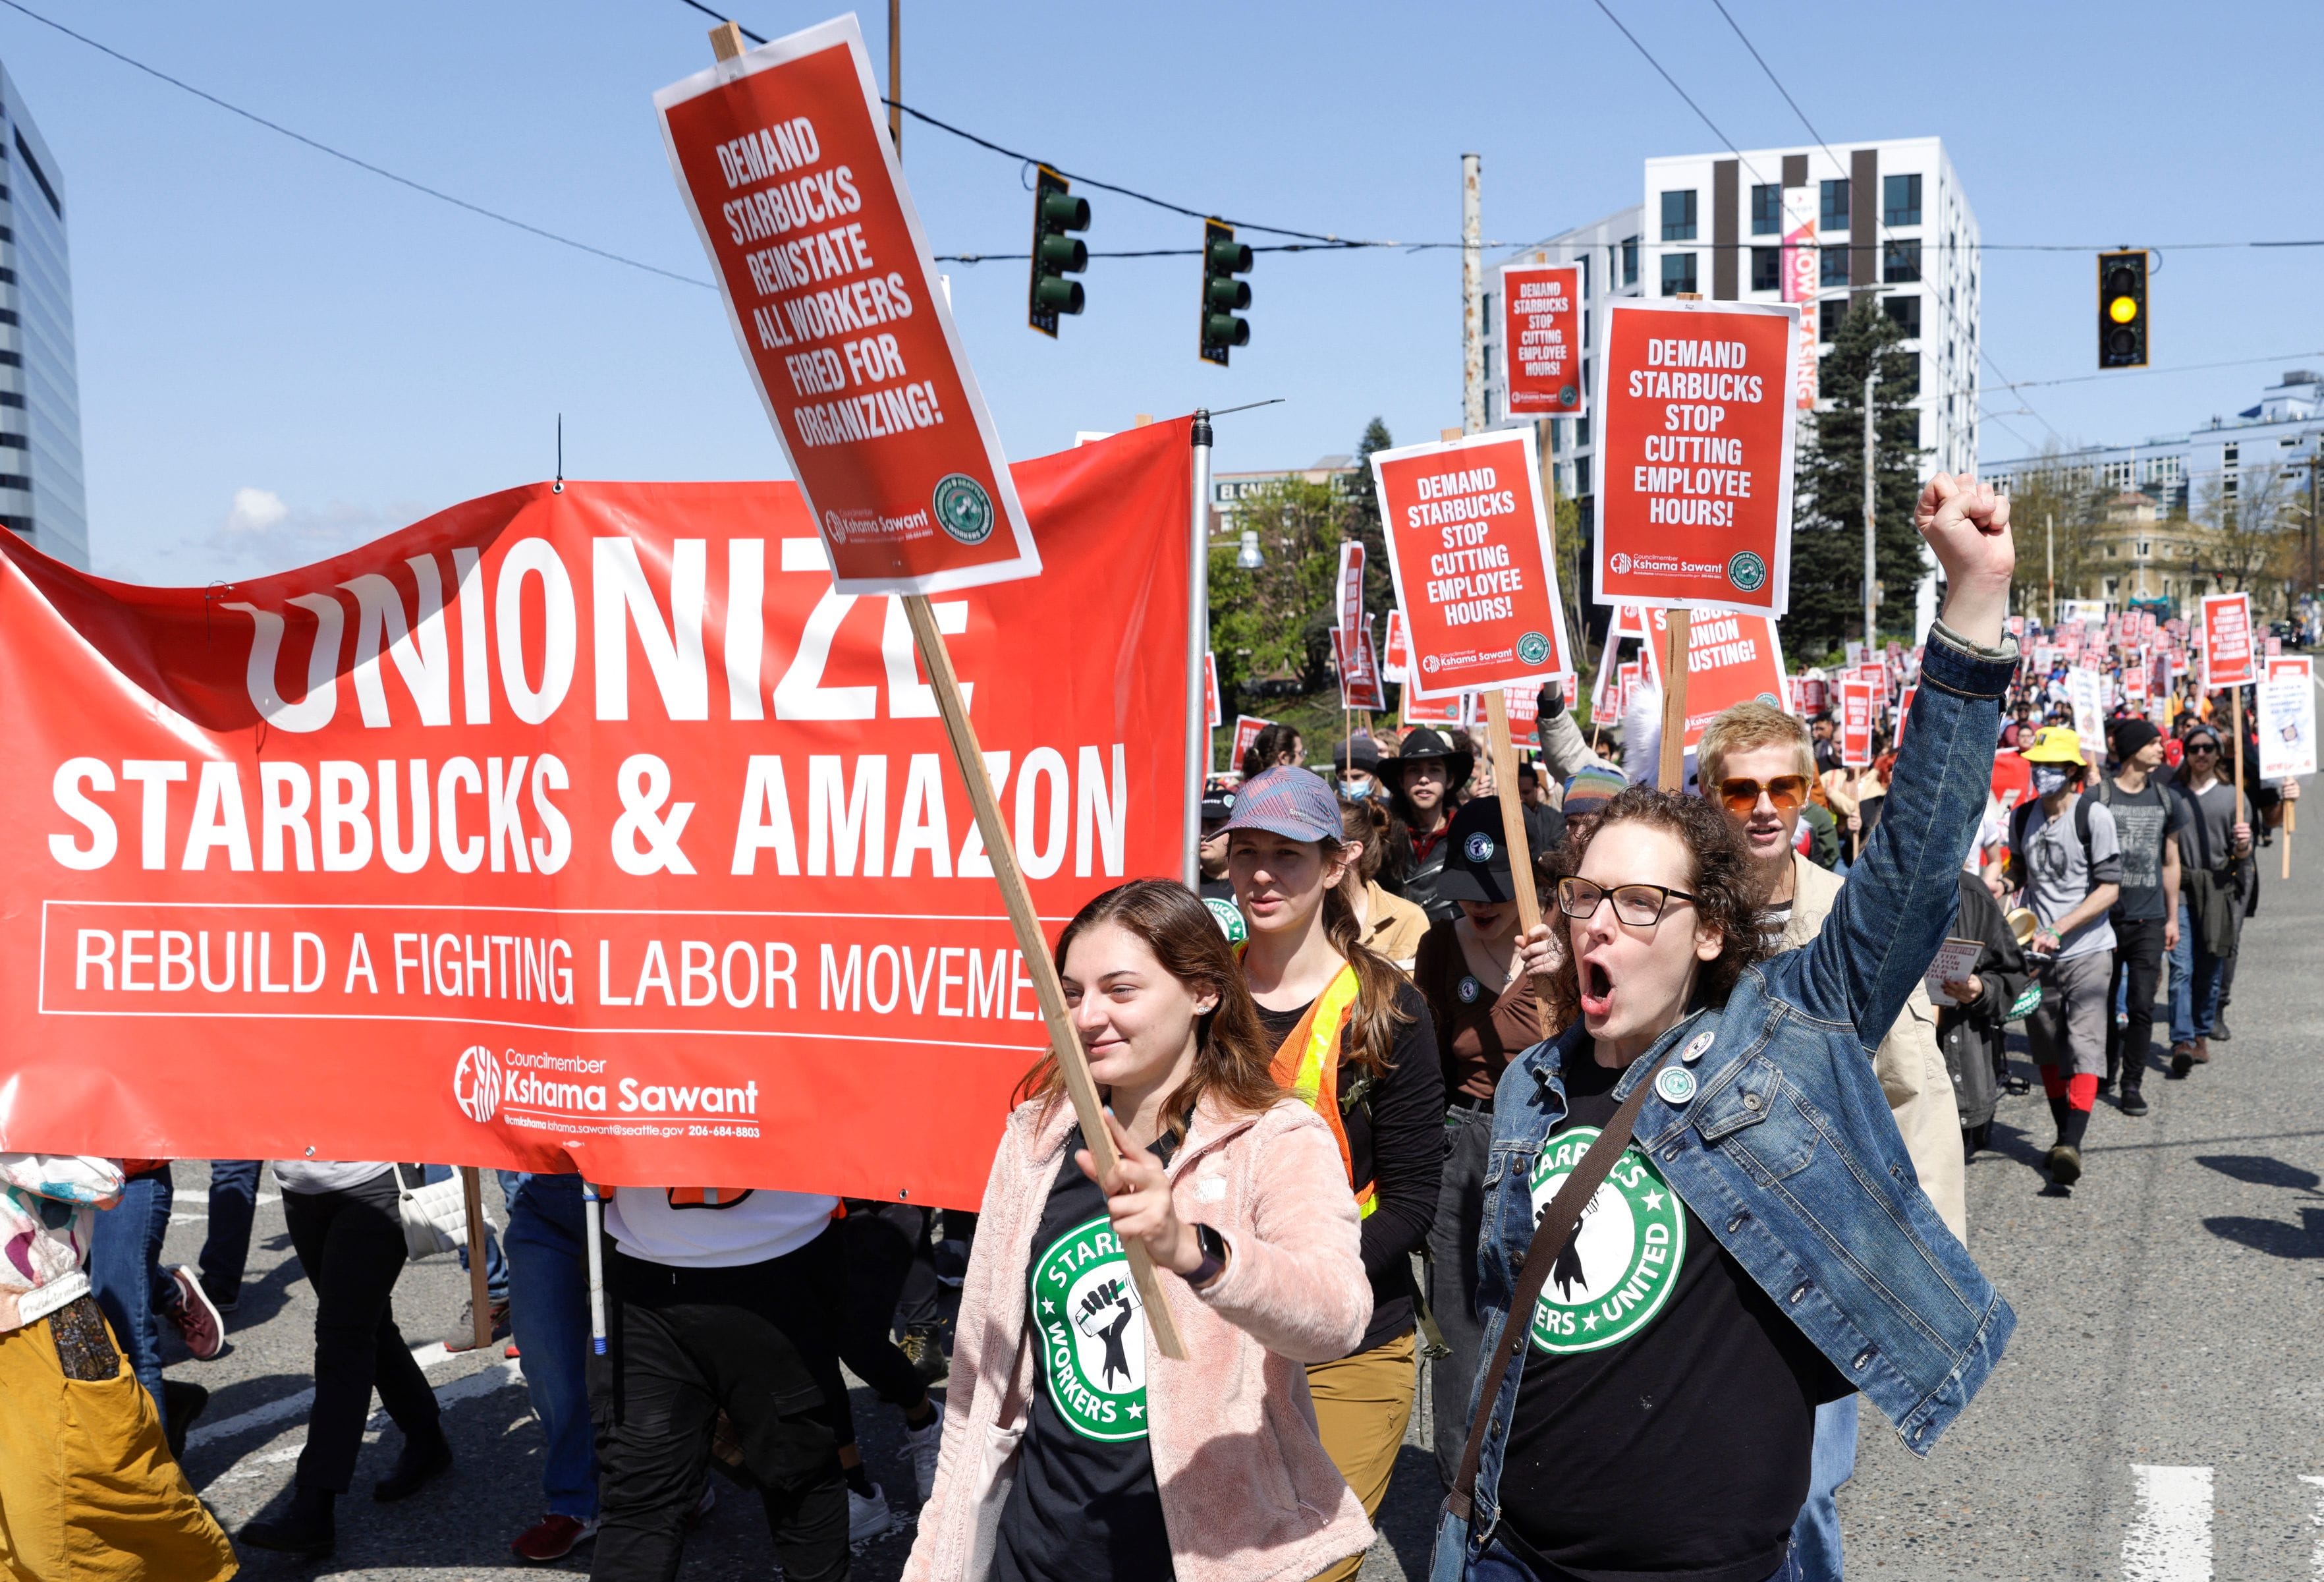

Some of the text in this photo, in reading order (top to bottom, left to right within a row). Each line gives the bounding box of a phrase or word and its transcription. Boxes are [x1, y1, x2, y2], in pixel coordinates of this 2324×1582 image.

[716, 116, 820, 190] DEMAND
[723, 166, 862, 246] STARBUCKS
[746, 222, 873, 297] REINSTATE
[1796, 236, 1815, 295] NOW
[1514, 297, 1568, 314] STARBUCKS
[1520, 282, 1561, 298] DEMAND
[753, 272, 913, 351] ALL WORKERS
[1529, 314, 1553, 329] STOP
[1518, 345, 1566, 360] EMPLOYEE
[1522, 330, 1561, 345] CUTTING
[1647, 337, 1747, 369] DEMAND
[785, 333, 906, 397] FIRED FOR
[1526, 361, 1560, 376] HOURS!
[1628, 370, 1763, 403] STARBUCKS
[794, 381, 945, 448] ORGANIZING!
[1665, 404, 1725, 432] STOP
[1645, 436, 1742, 466] CUTTING
[1417, 467, 1496, 501] DEMAND
[1634, 466, 1751, 498] EMPLOYEE
[843, 509, 929, 534] Kshama Sawant
[1407, 491, 1515, 528] STARBUCKS
[1649, 497, 1734, 527] HOURS!
[949, 523, 980, 540] WORKERS
[1442, 521, 1489, 549] STOP
[1431, 544, 1510, 577] CUTTING
[1634, 559, 1723, 573] Kshama Sawant
[1426, 569, 1522, 604] EMPLOYEE
[1732, 576, 1752, 589] WORKERS
[1752, 573, 1763, 588] UNITED
[1444, 595, 1513, 627] HOURS!
[217, 536, 974, 733] UNIONIZE
[1689, 618, 1740, 648] UNION
[1441, 656, 1477, 666] Kshama
[1479, 648, 1512, 661] Sawant
[1688, 639, 1756, 673] USTING!
[48, 743, 1127, 878] STARBUCKS & AMAZON
[75, 929, 1046, 1021] REBUILD A FIGHTING LABOR MOVEME
[505, 1048, 606, 1073] Councilmember
[505, 1071, 758, 1114] Kshama Sawant
[504, 1115, 760, 1139] @cmkshama kshama.sawant@seattle.gov 206-684-8803
[1601, 1222, 1669, 1322] UNITED
[1047, 1321, 1117, 1423] WORKERS
